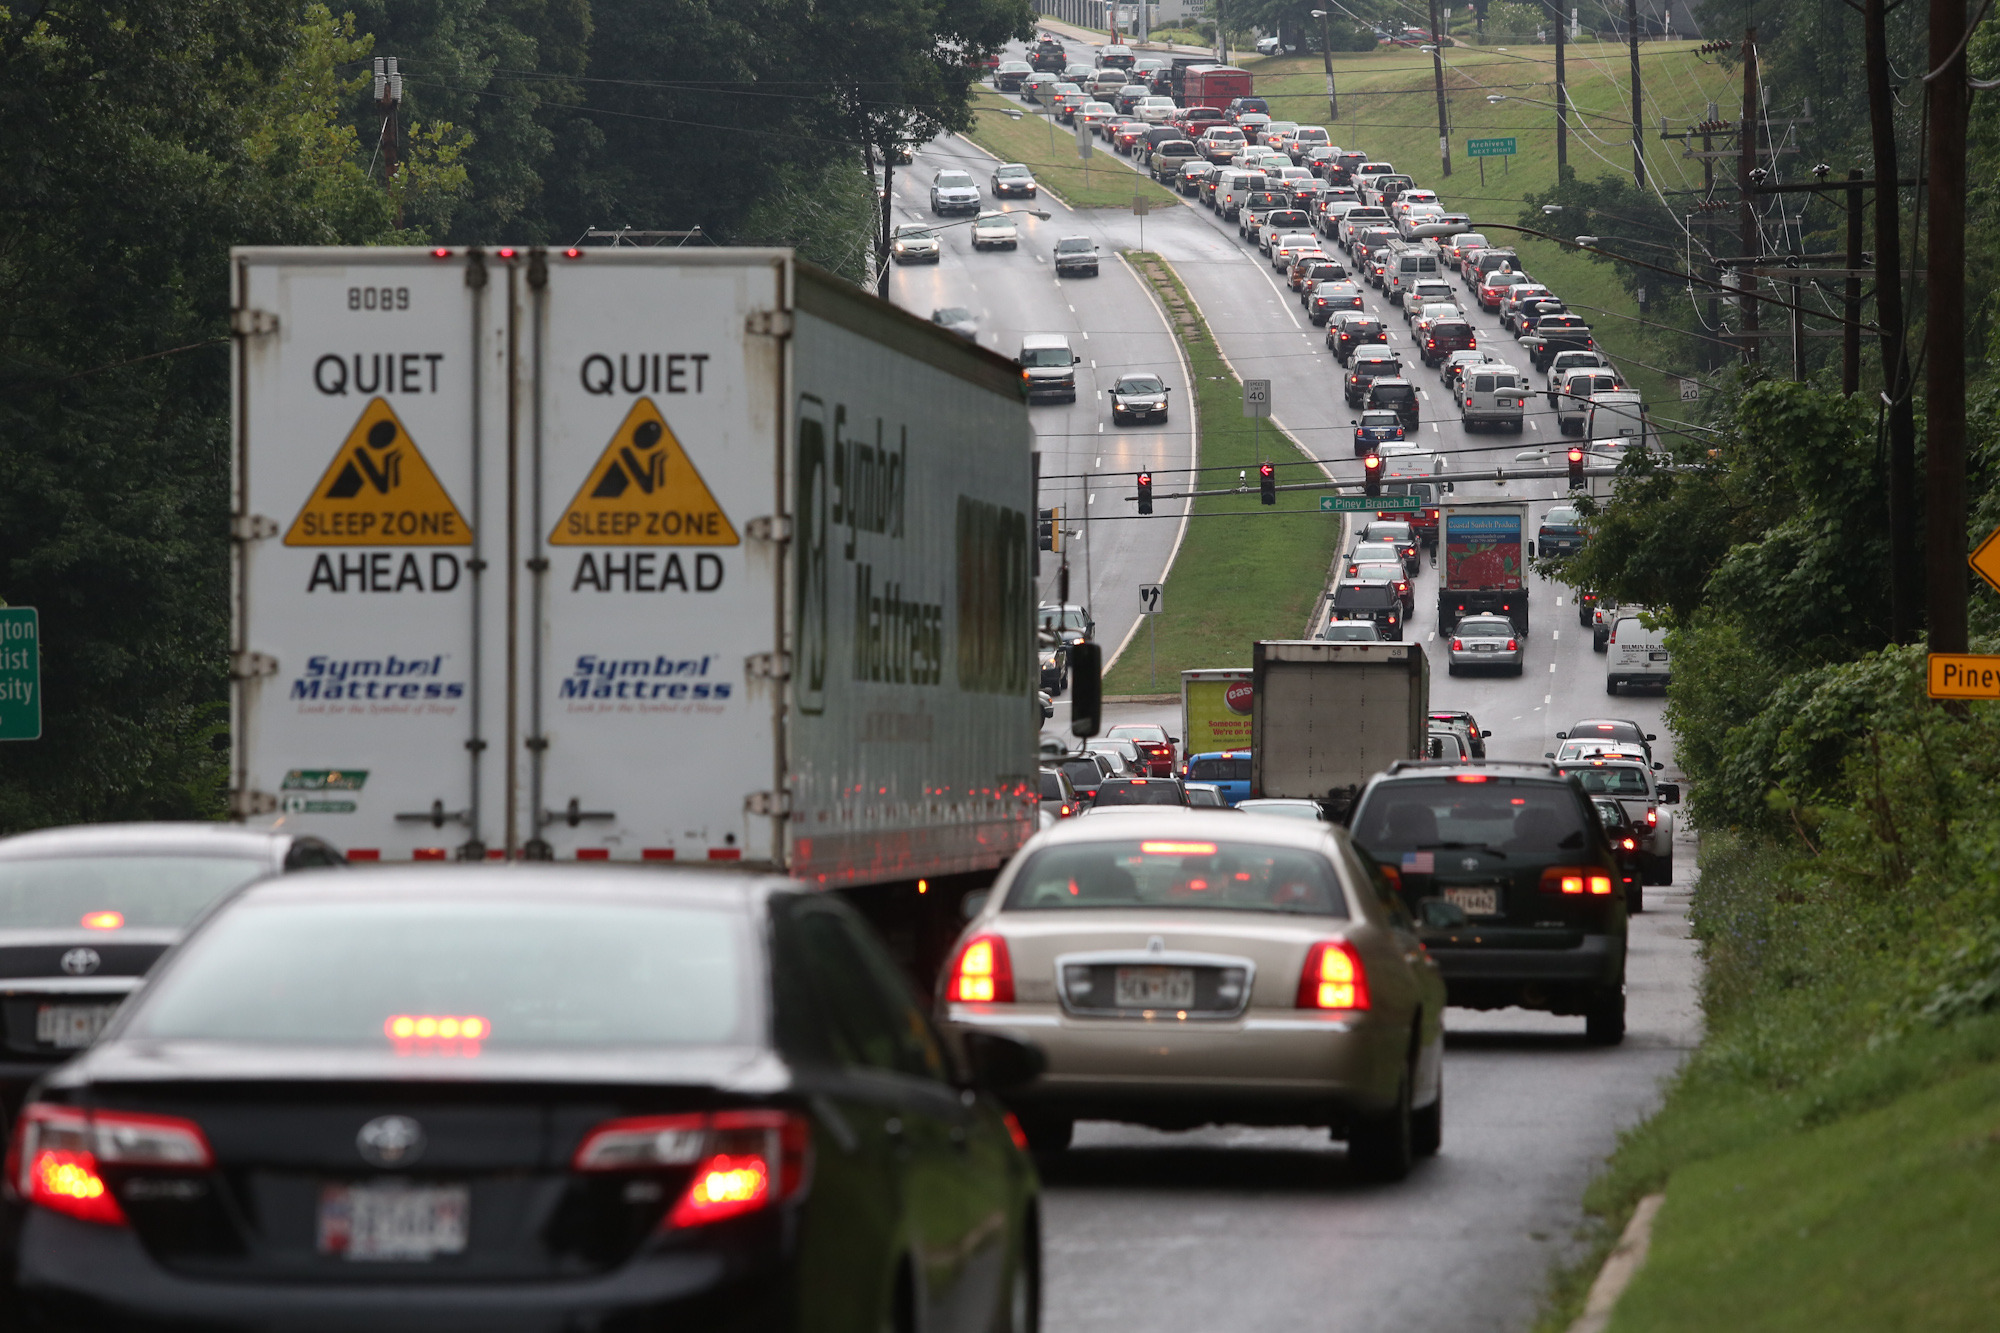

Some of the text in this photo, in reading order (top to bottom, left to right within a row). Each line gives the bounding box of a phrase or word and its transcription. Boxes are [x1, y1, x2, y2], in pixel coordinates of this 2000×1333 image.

[348, 287, 409, 311] 8089
[314, 353, 444, 396] QUIET
[580, 353, 710, 396] QUIET
[1249, 391, 1264, 400] 40
[1682, 390, 1698, 399] 40
[1335, 498, 1415, 510] Piney Branch Rd
[302, 511, 455, 536] SLEEP ZONE
[567, 511, 719, 536] SLEEP ZONE
[1471, 520, 1493, 528] Sunbelt
[1494, 520, 1519, 528] Produce
[307, 553, 460, 593] AHEAD
[572, 553, 724, 593] AHEAD
[306, 655, 442, 682] Symbol
[574, 655, 710, 682] Symbol
[290, 679, 465, 700] Mattress
[559, 679, 732, 700] Mattress
